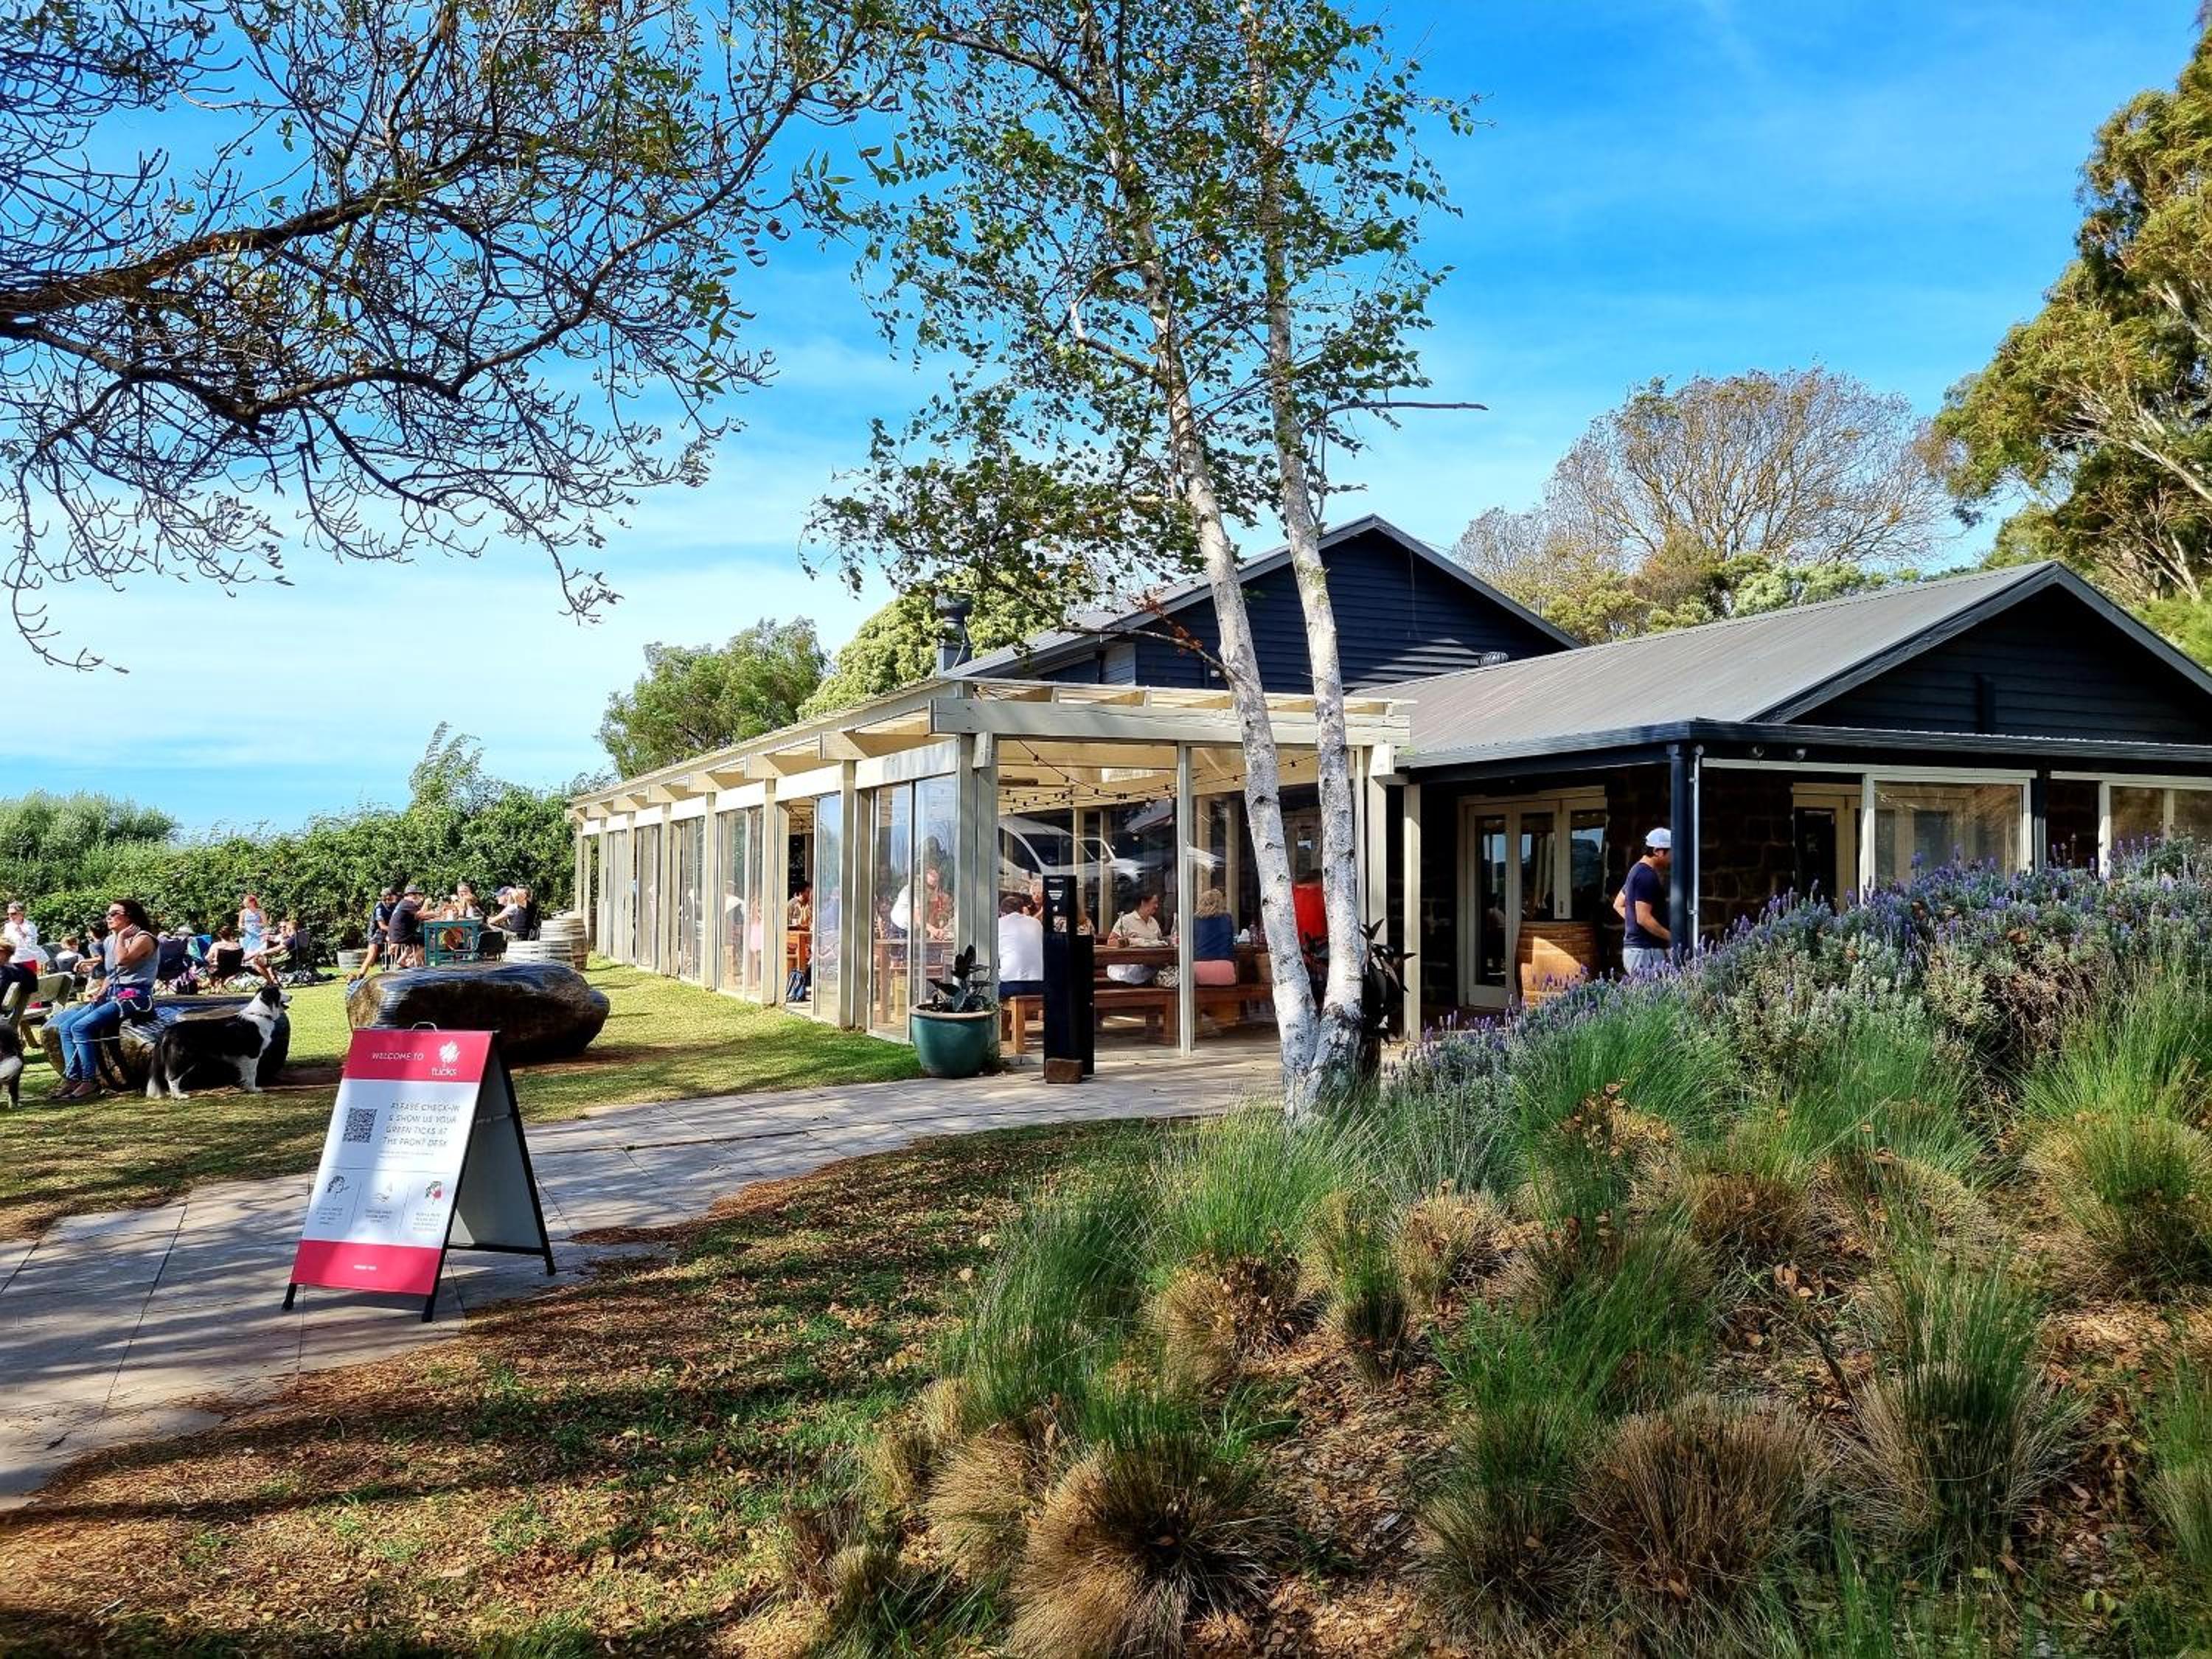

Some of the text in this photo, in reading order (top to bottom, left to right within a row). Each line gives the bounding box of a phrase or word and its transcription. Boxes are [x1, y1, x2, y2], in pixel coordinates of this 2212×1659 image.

[372, 1052, 425, 1061] WELCOME TO
[391, 1102, 460, 1113] PLEASE CHECK-IN
[396, 1114, 421, 1122] SHOW
[422, 1115, 433, 1123] US
[436, 1116, 456, 1124] YOUR
[414, 1126, 436, 1135] TICKS
[437, 1127, 448, 1135] AT
[383, 1136, 448, 1147] THE FRONT DESK
